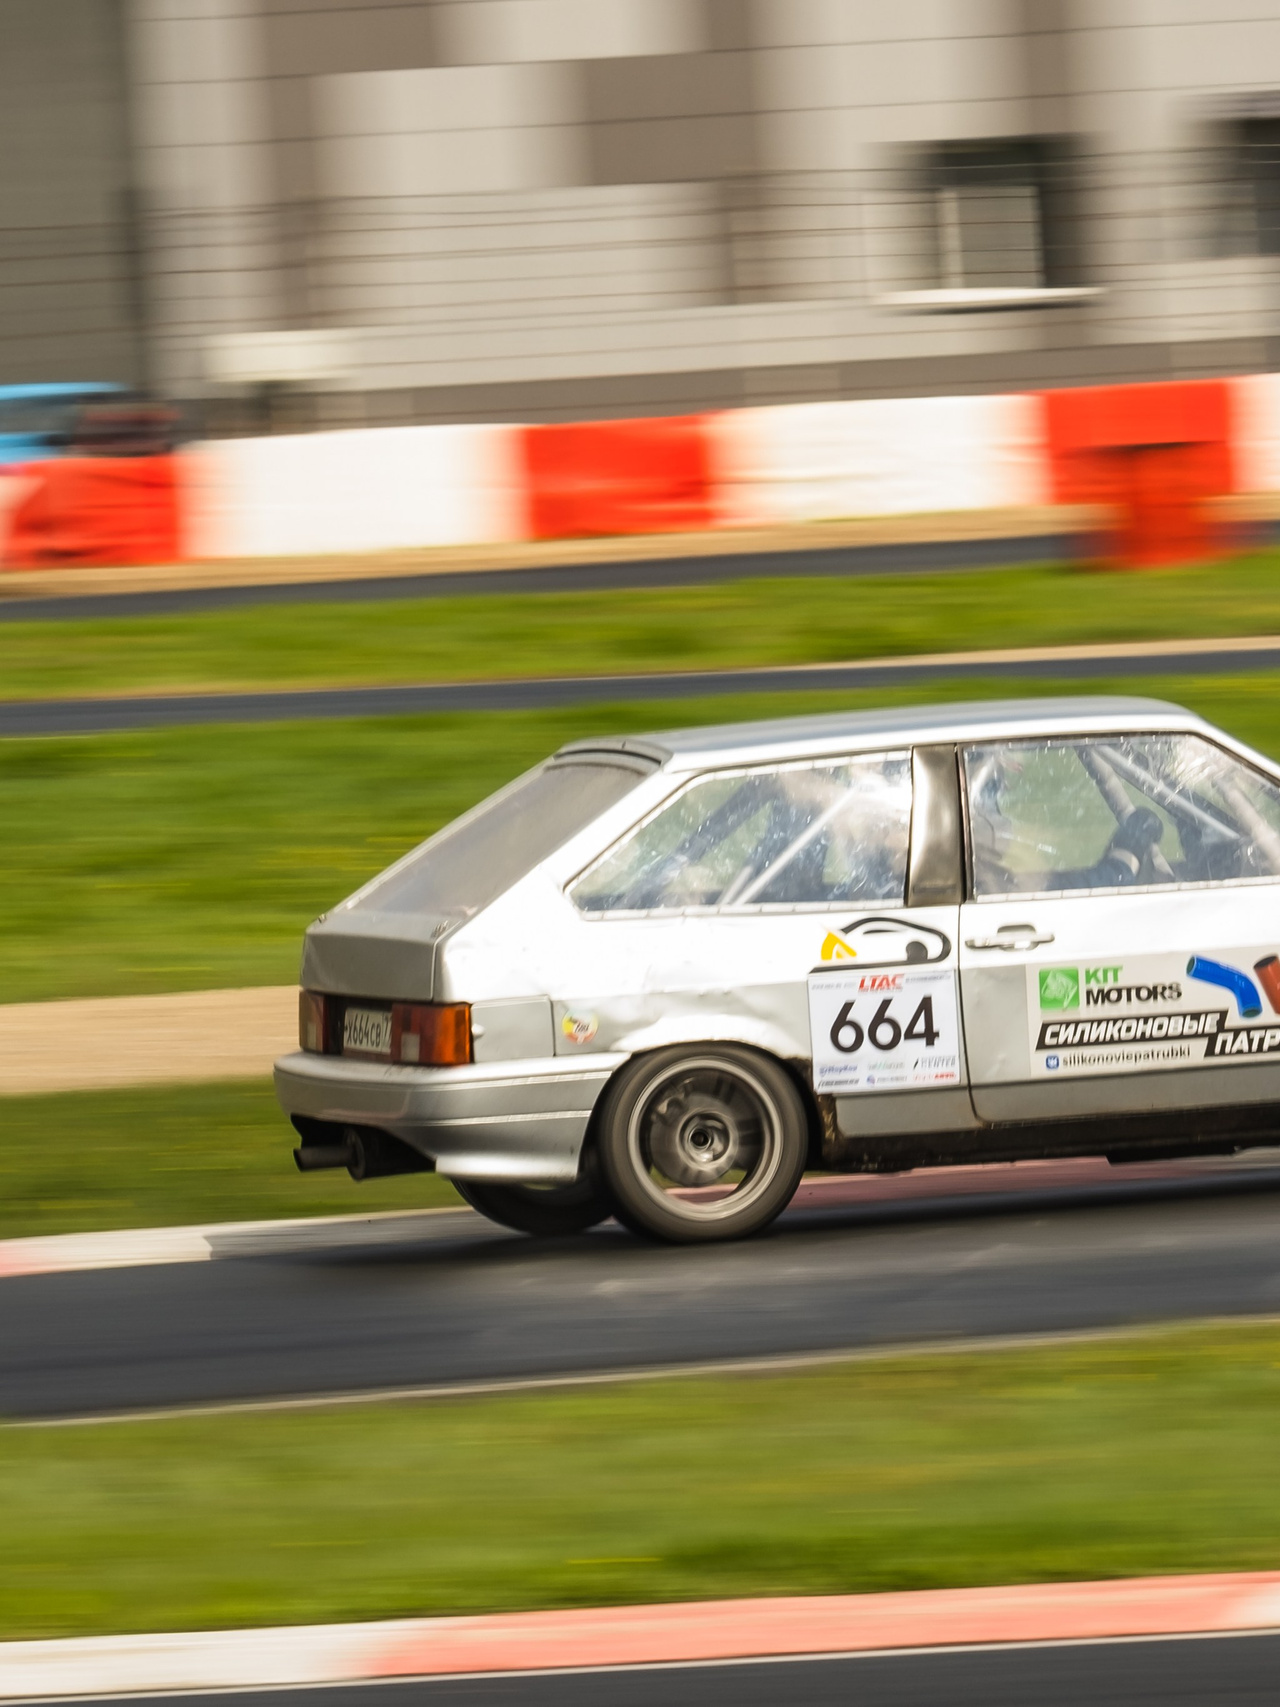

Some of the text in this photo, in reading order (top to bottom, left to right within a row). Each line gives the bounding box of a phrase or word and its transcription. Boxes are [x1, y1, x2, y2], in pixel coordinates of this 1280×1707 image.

[858, 974, 905, 990] LTAC
[1085, 965, 1123, 985] KIT
[1085, 982, 1183, 1008] MOTORS
[830, 994, 939, 1053] 664
[1044, 1012, 1220, 1046] СИЛИКОНОВЫЕ
[1063, 1044, 1191, 1068] silikonoviepatrubki
